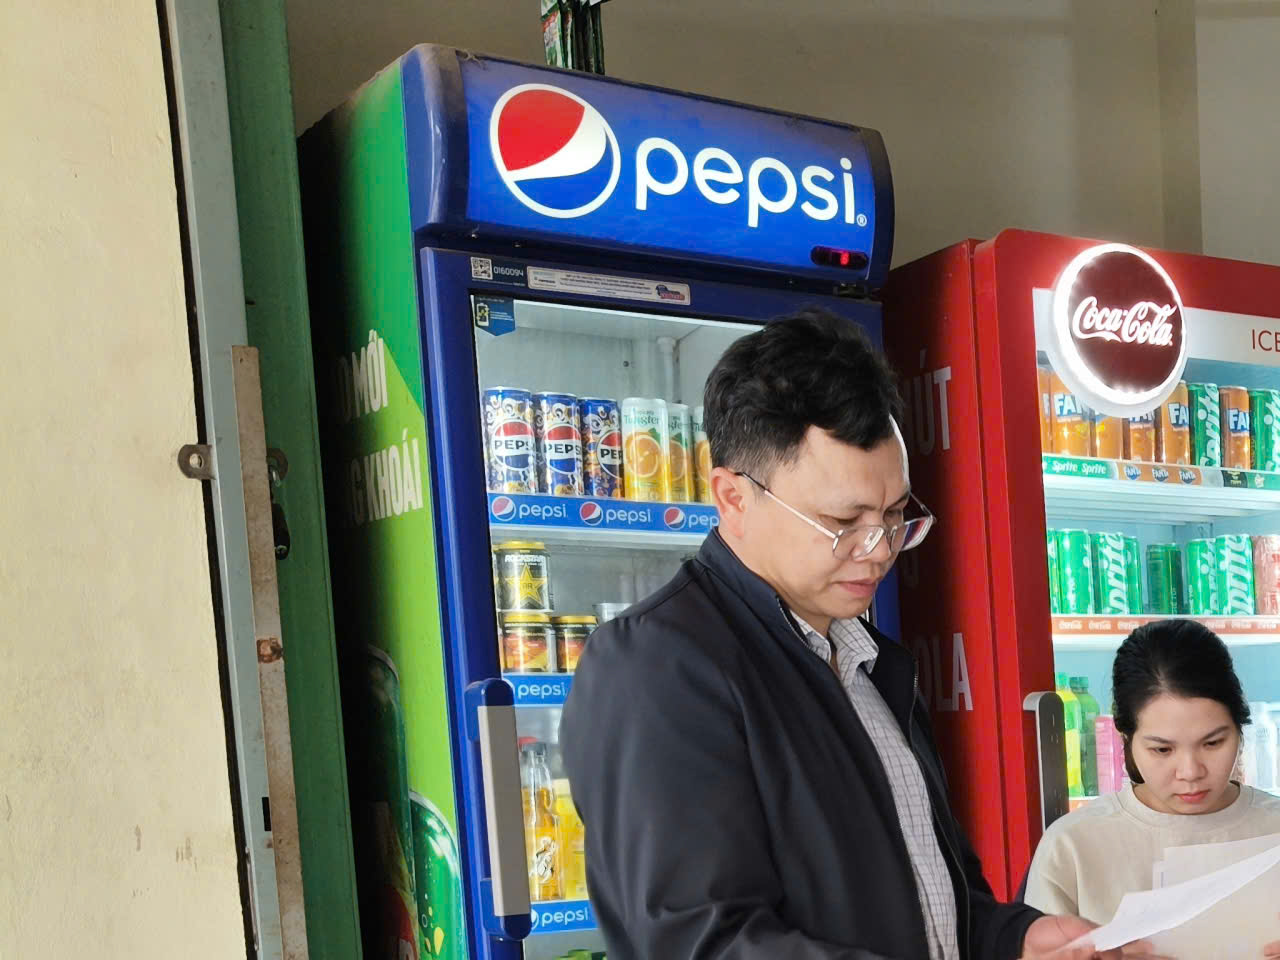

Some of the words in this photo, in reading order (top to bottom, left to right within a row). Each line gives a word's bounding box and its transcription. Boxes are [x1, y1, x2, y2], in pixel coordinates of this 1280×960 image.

[635, 137, 857, 229] pepsi
[1072, 296, 1176, 347] Coca-Cola
[494, 438, 533, 452] PEPS
[544, 442, 582, 455] PEPS
[600, 448, 623, 461] PEP
[519, 503, 567, 521] pepsi
[606, 508, 651, 526] pepsi
[688, 513, 719, 531] pep
[518, 681, 566, 699] pepsi
[541, 906, 589, 927] pepsi
